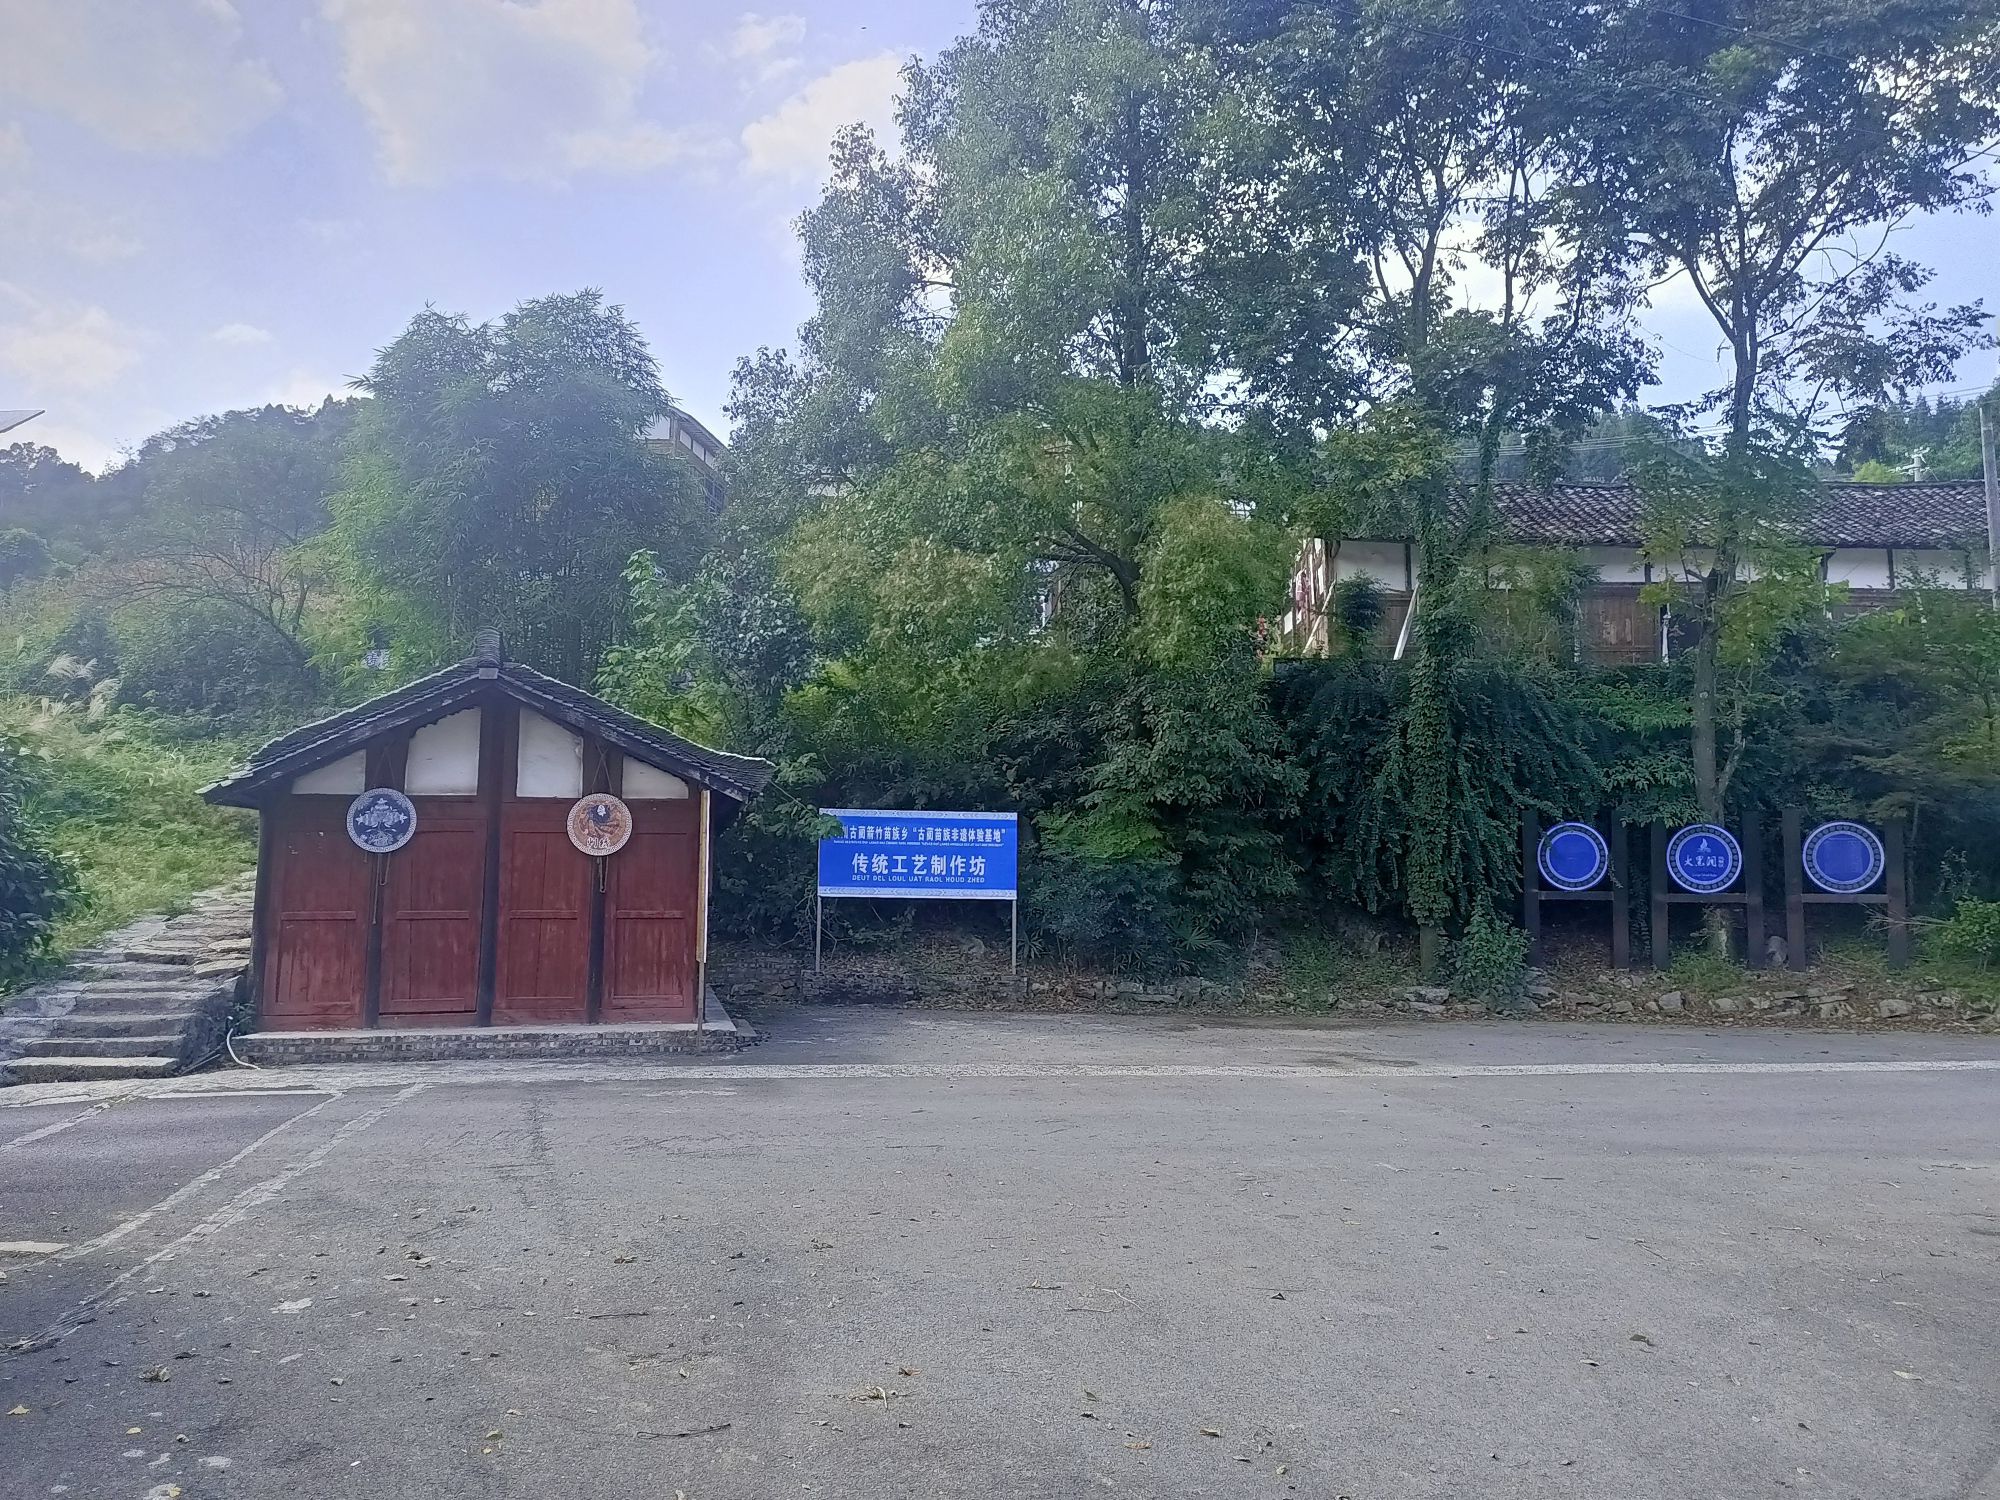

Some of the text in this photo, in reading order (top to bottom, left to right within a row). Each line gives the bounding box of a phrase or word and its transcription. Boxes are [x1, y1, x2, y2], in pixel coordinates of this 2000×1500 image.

[852, 852, 986, 876] 传统工艺制作坊
